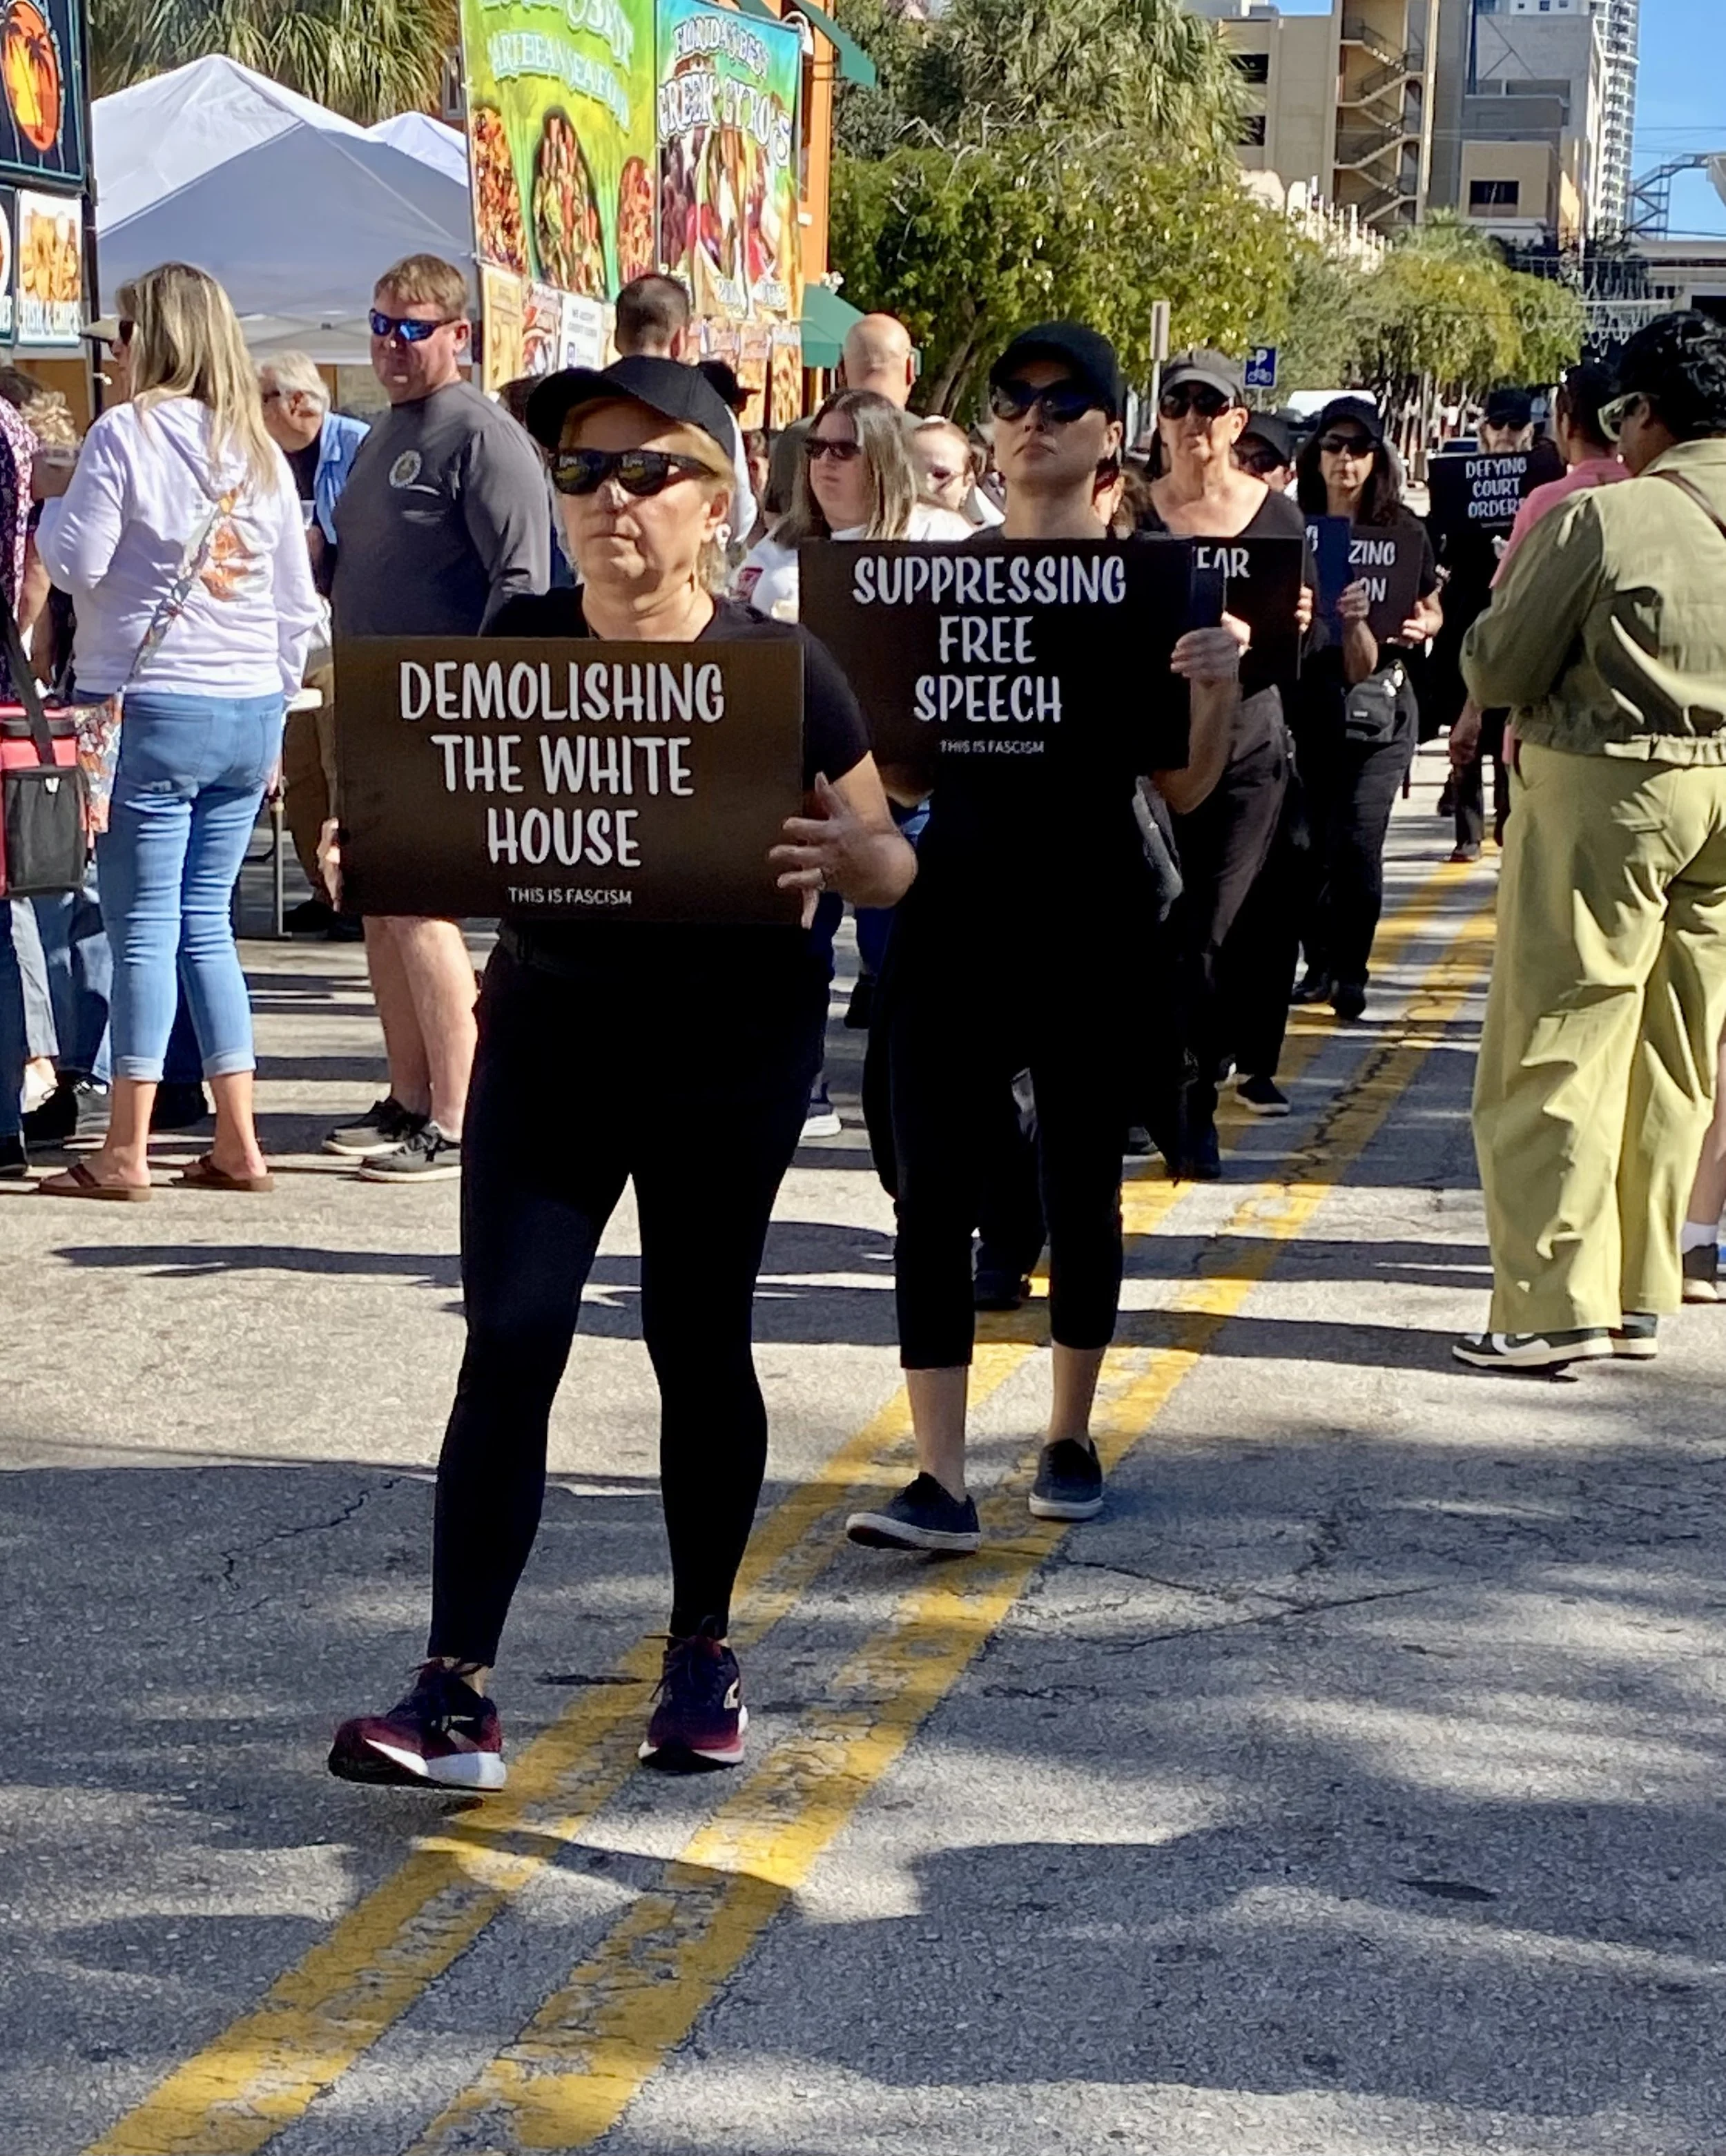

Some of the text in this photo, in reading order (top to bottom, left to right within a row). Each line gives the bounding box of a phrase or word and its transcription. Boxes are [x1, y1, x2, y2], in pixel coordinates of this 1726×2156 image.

[1255, 349, 1268, 366] P
[1465, 456, 1527, 479] DEFYING
[1472, 477, 1520, 498] COURT
[852, 555, 1126, 605] SUPPRESSING
[940, 615, 1036, 664] FREE
[400, 661, 725, 723] DEMOLISHING
[913, 674, 1063, 723] SPEECH
[430, 735, 695, 796] THE WHITE
[940, 739, 1044, 754] THIS IS FASCISM
[487, 807, 641, 867] HOUSE
[508, 886, 632, 905] THIS IS FASCISM
